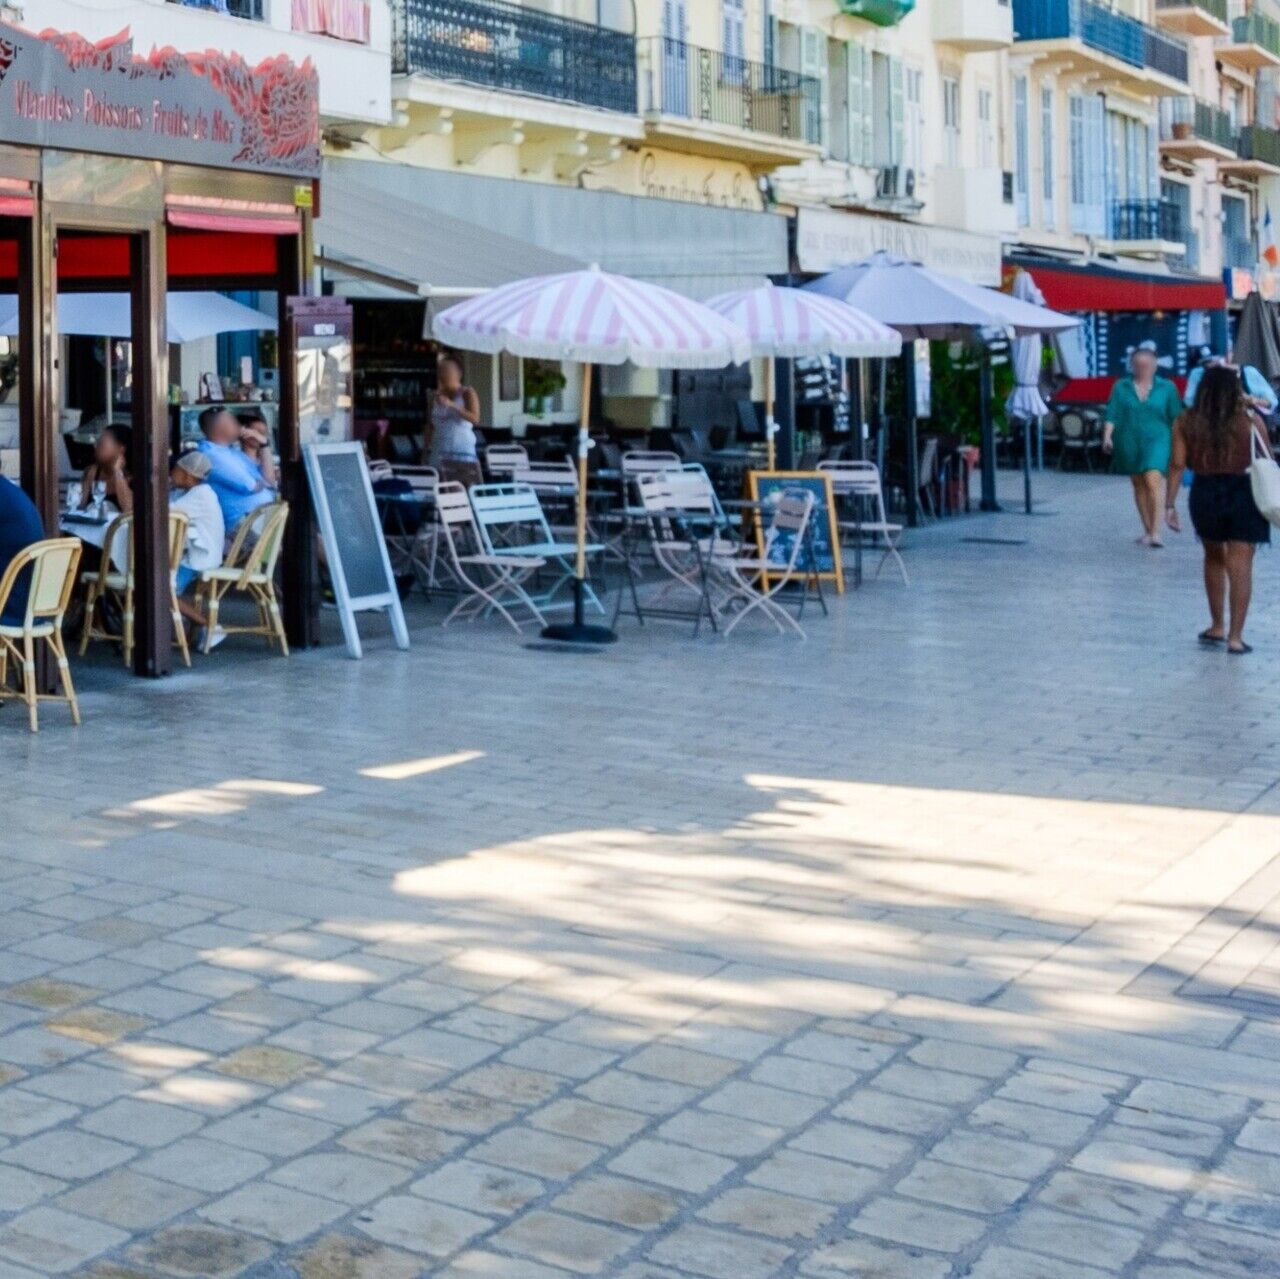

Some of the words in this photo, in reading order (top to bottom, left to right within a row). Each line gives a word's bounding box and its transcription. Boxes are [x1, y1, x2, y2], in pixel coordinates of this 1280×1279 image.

[15, 79, 73, 122] Viandes
[83, 87, 143, 130] Poissons
[152, 99, 190, 138] Fruits
[193, 107, 209, 140] de
[211, 108, 236, 144] Mer
